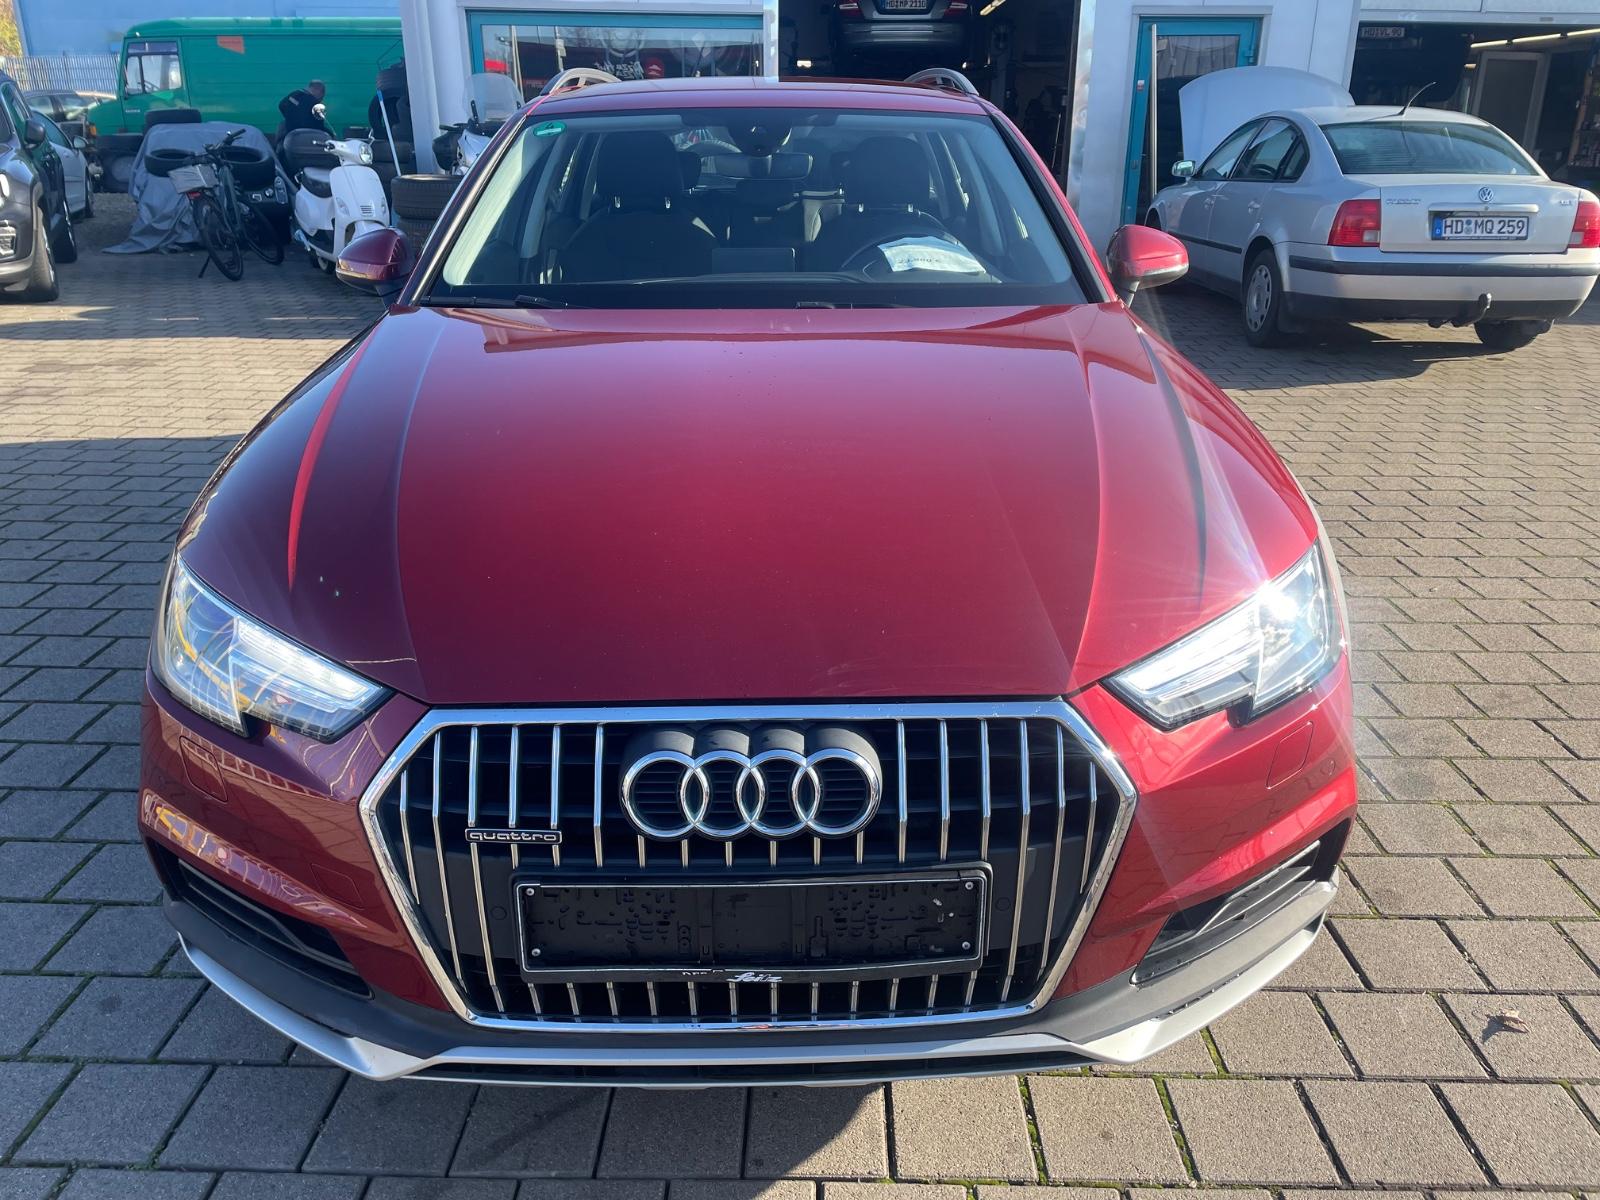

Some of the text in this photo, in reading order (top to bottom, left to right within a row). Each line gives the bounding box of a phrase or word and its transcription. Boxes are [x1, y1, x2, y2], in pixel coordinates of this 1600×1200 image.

[1443, 219, 1464, 235] HD
[1473, 219, 1494, 235] MQ
[1497, 219, 1525, 235] 259
[470, 832, 556, 841] quattro
